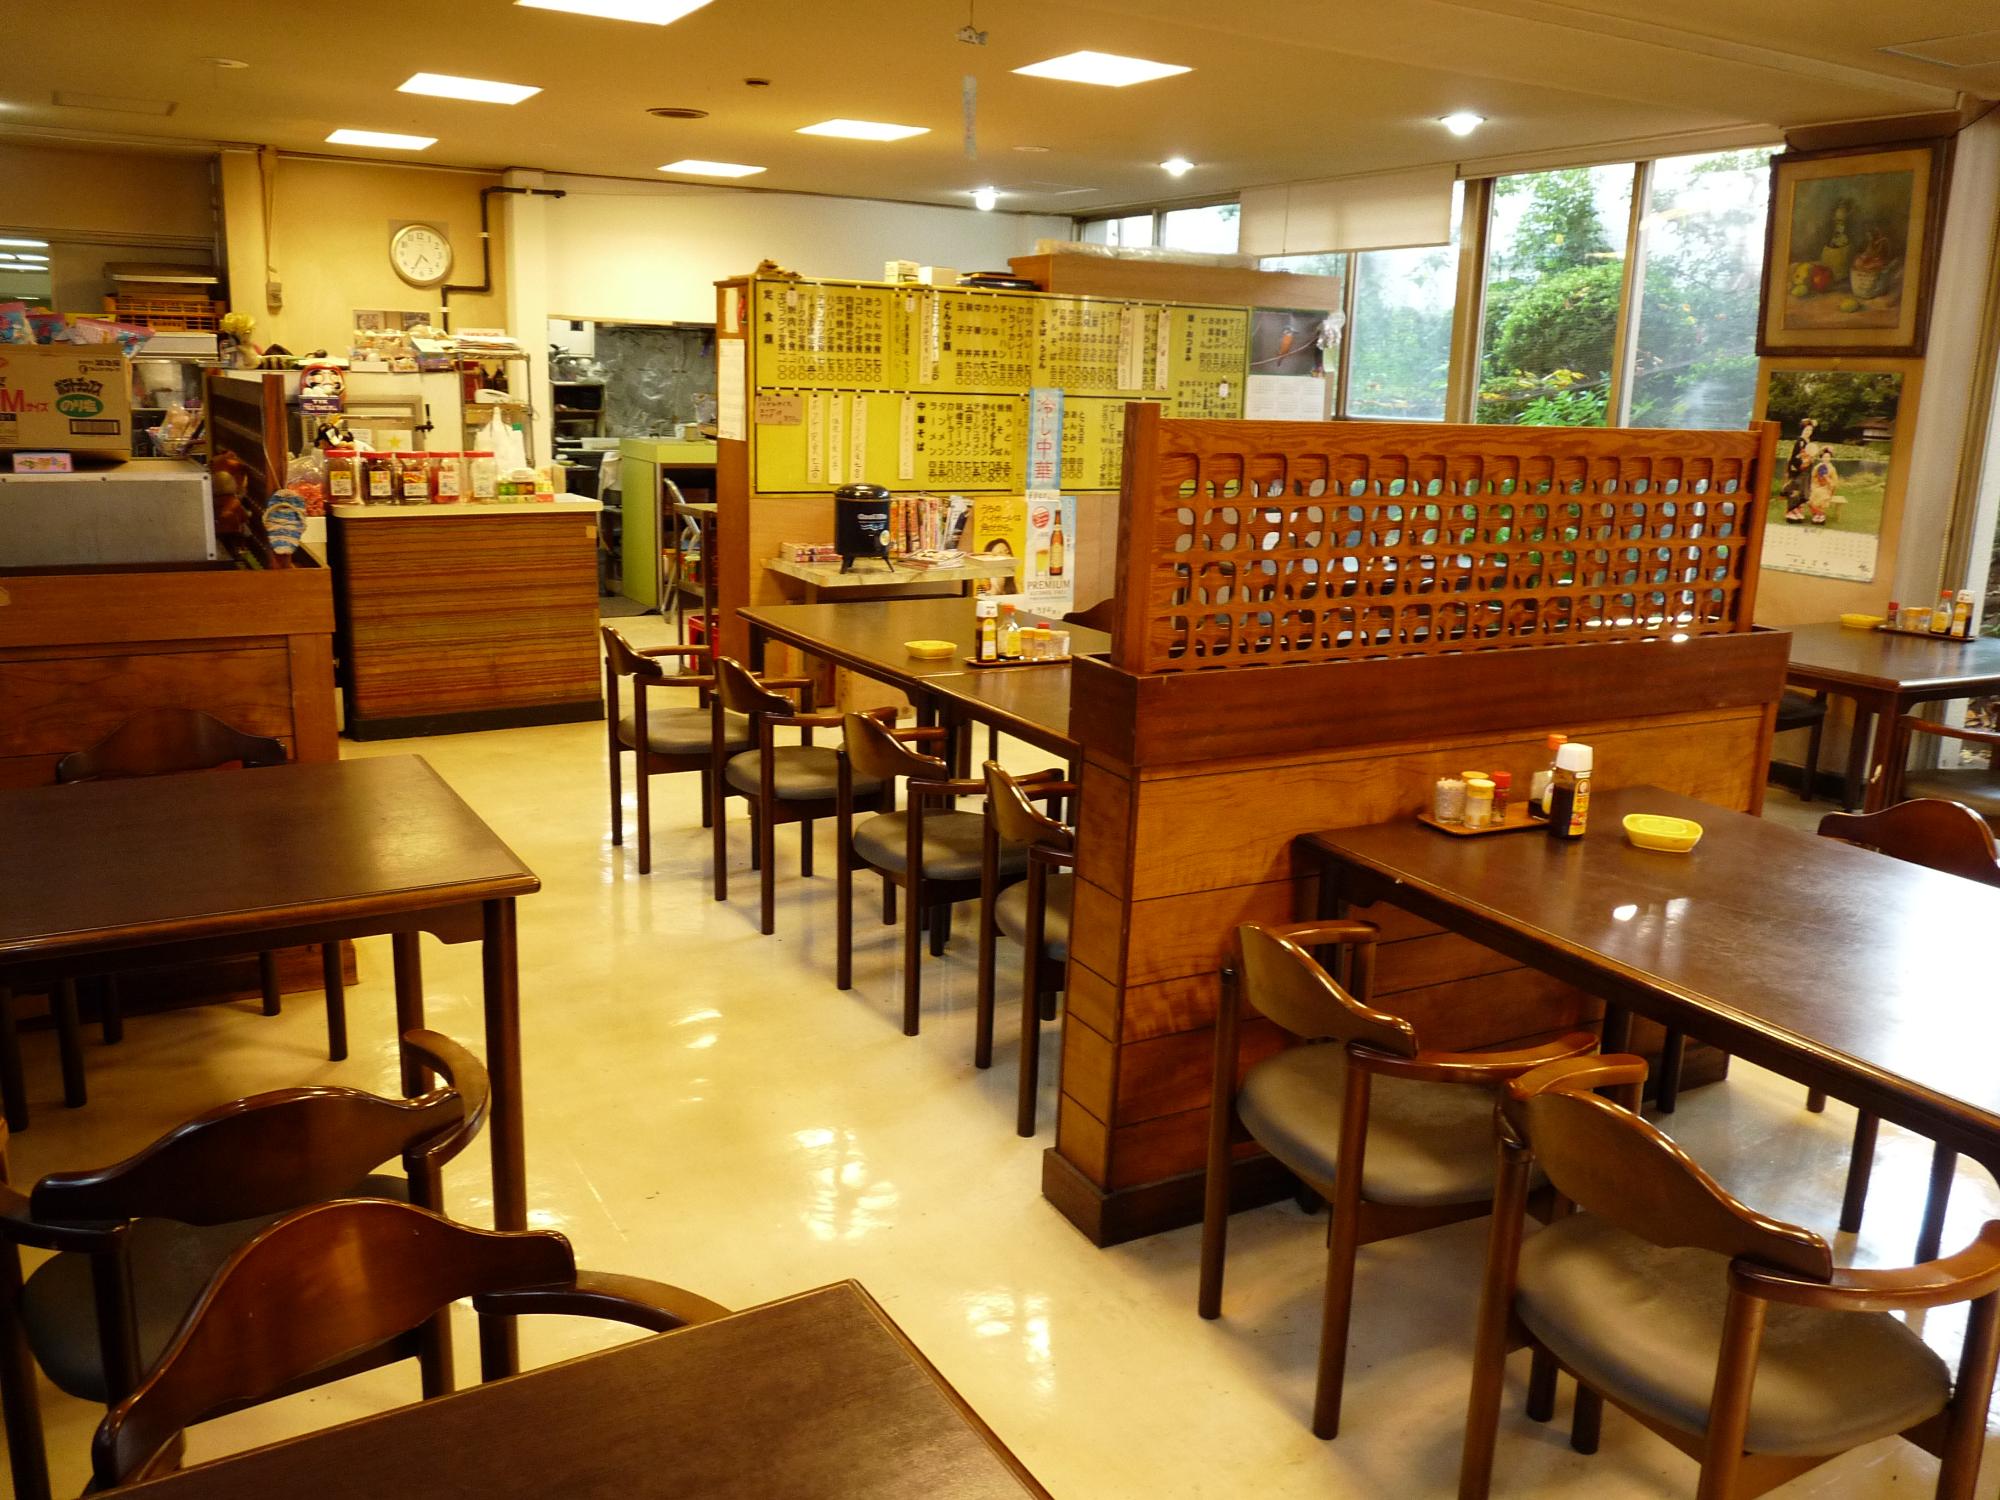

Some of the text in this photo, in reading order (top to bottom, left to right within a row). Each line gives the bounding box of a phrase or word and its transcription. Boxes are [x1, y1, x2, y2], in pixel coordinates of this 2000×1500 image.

[778, 292, 787, 351] エビフライ定食
[864, 297, 872, 354] おでん定食
[873, 298, 881, 354] うどん定食
[956, 302, 964, 358] 玉子丼
[1008, 306, 1016, 359] ドライカレー
[1025, 306, 1033, 360] カツカレー
[60, 399, 98, 413] のり塩
[917, 402, 926, 452] 中華そば
[929, 401, 937, 456] ラーメン
[938, 402, 946, 456] タンメン
[1035, 397, 1055, 479] 冷し中華
[1027, 580, 1071, 591] PREMIUM
